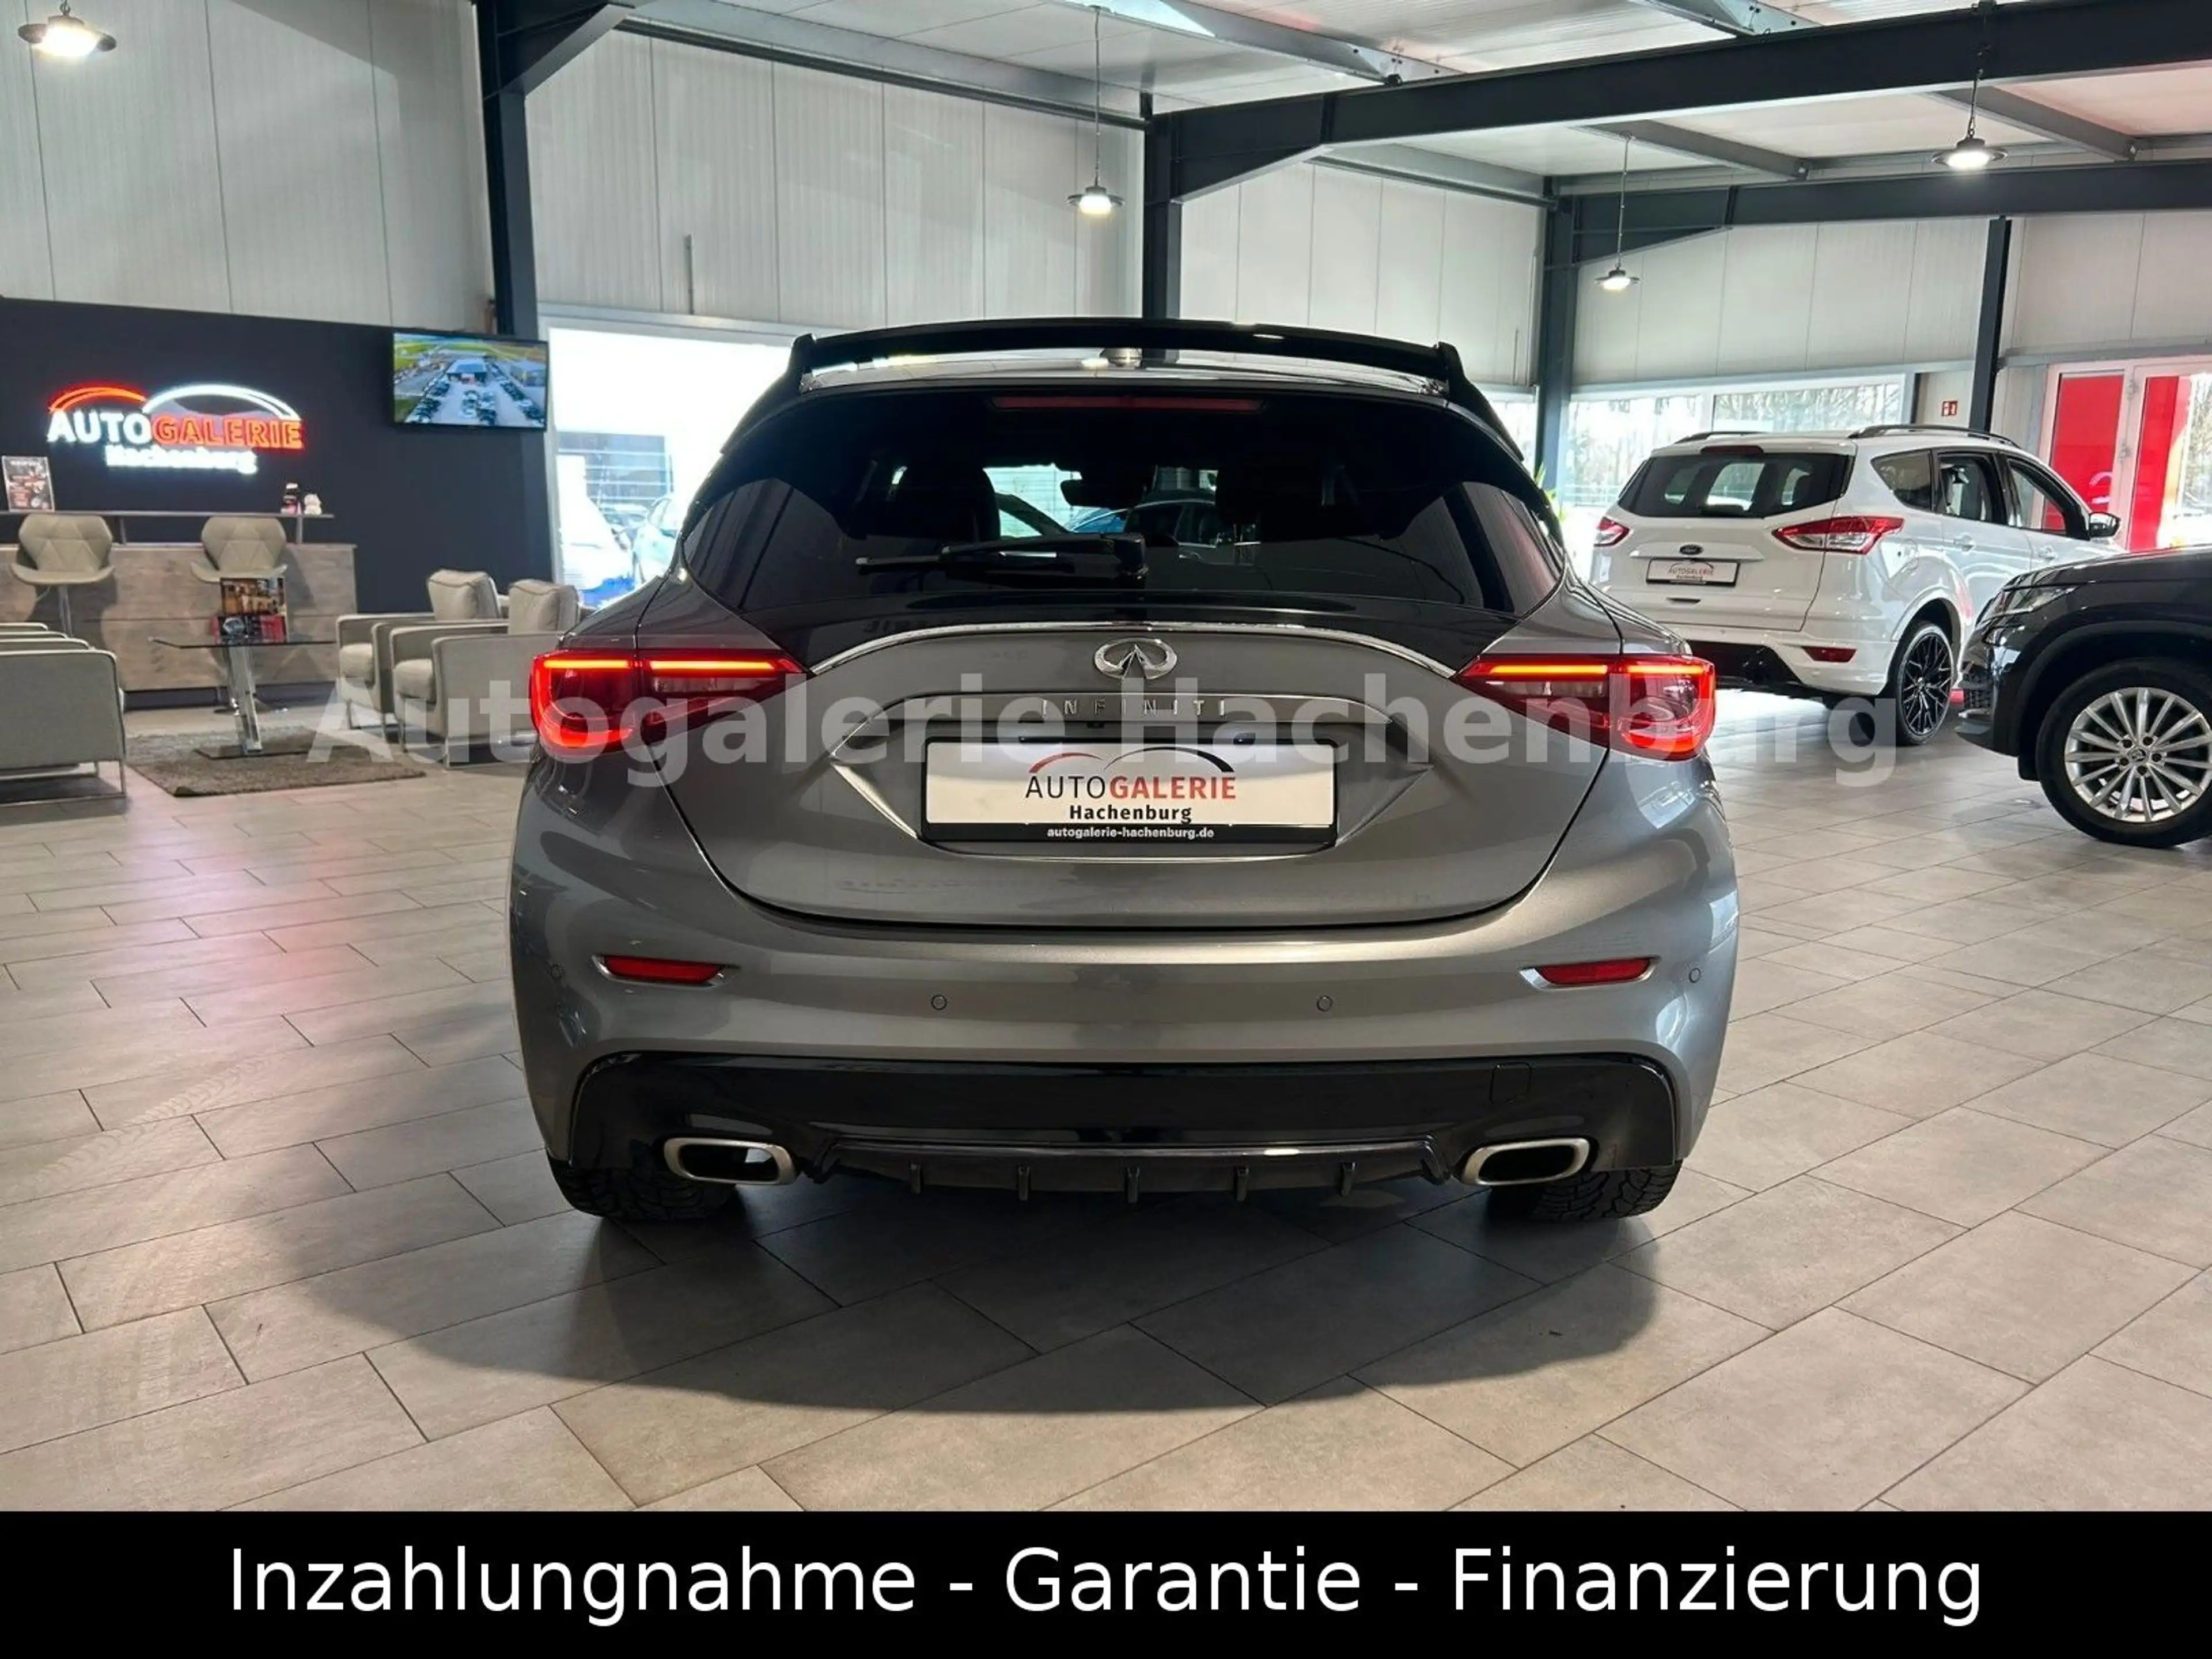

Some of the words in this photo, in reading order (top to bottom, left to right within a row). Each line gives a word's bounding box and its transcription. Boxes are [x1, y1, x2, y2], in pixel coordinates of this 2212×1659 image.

[47, 410, 303, 449] AUTOGALERIE
[1041, 699, 1226, 715] INFINITI
[1025, 775, 1236, 800] AUTOGALERIE
[1069, 805, 1192, 824] Hachenburg
[1047, 826, 1214, 839] autogalerie-hachenburg.de
